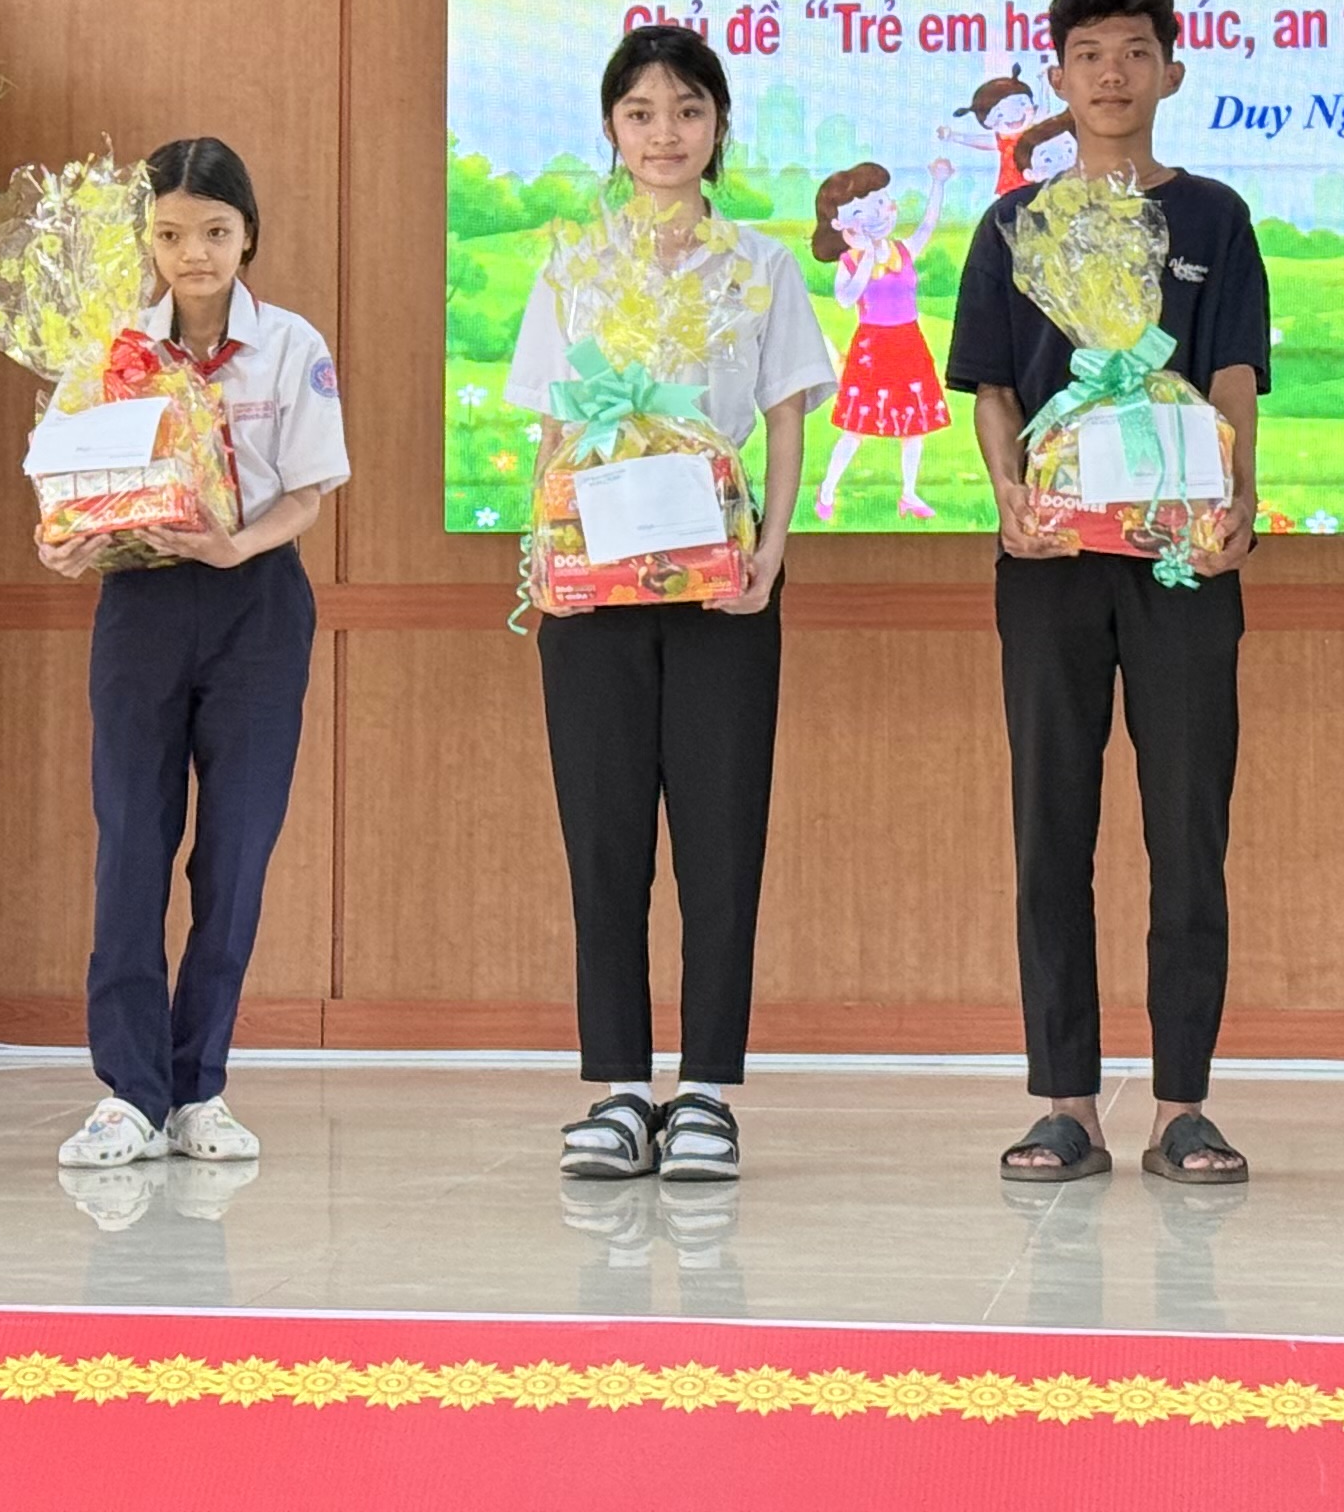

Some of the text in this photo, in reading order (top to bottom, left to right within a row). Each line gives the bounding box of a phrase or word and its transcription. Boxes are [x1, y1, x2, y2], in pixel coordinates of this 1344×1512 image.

[726, 0, 780, 55] đề
[918, 12, 986, 53] em
[1274, 11, 1327, 48] an
[1209, 95, 1292, 139] Duy
